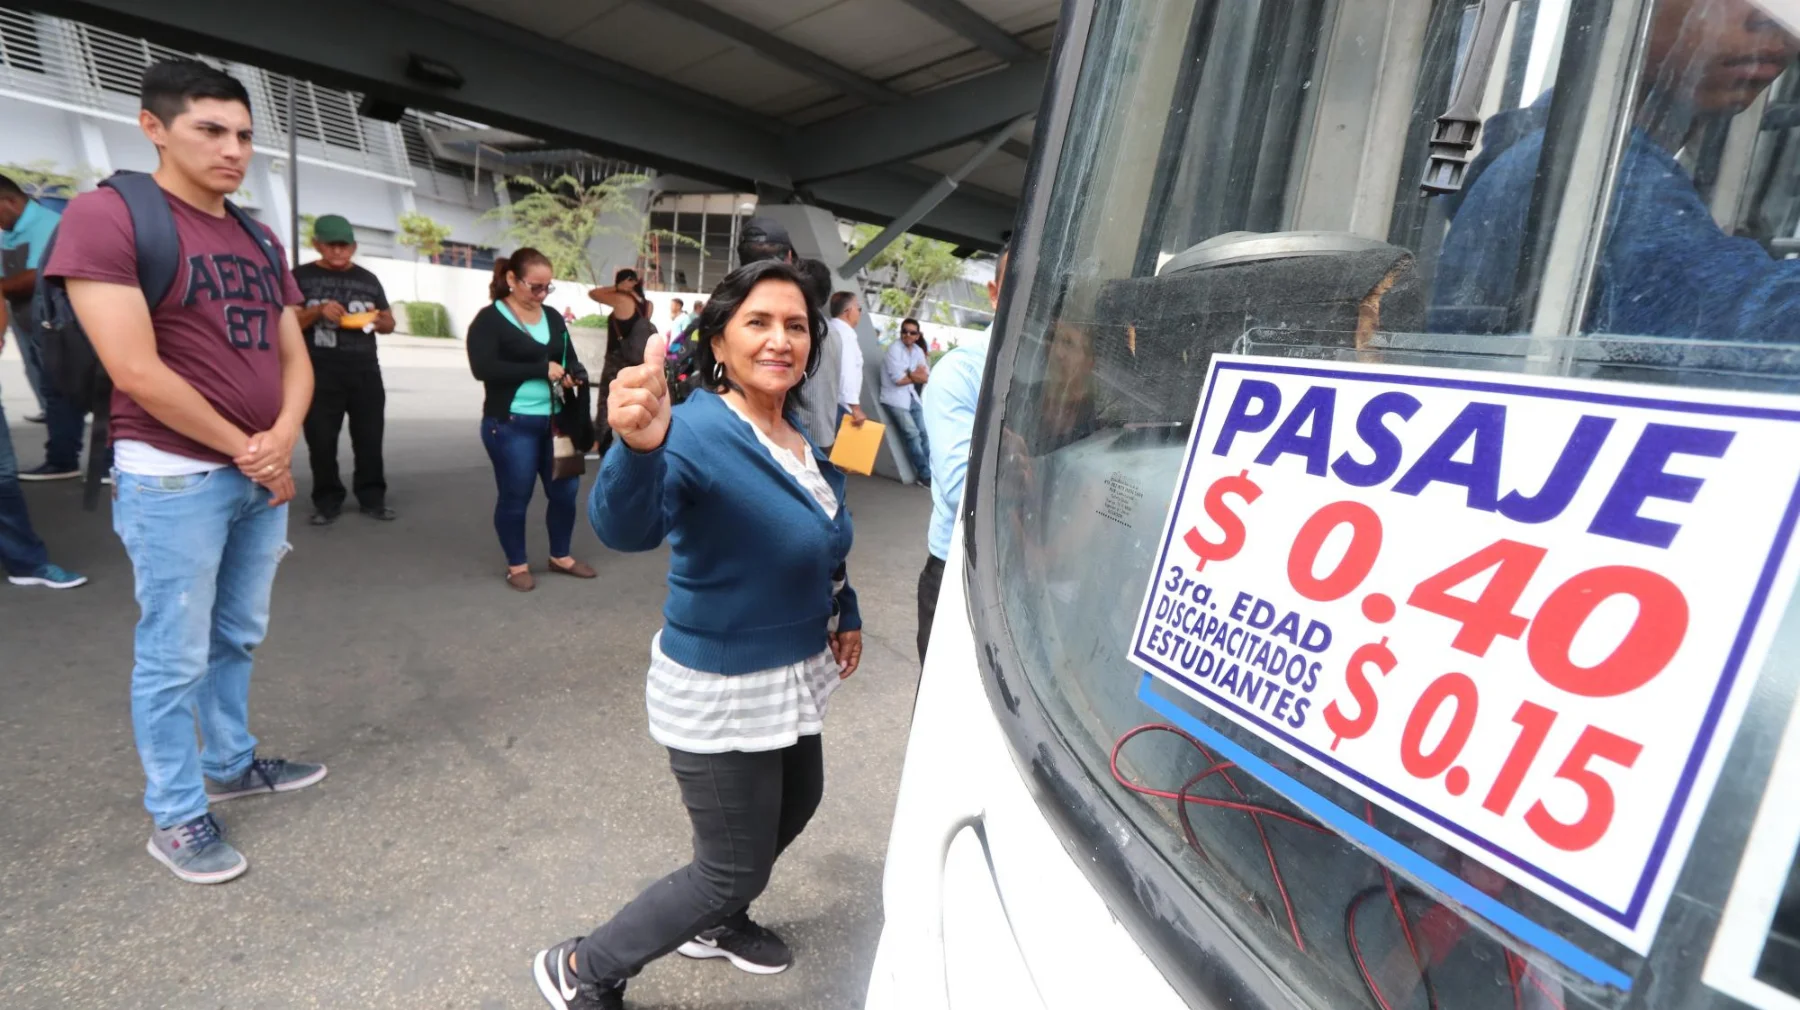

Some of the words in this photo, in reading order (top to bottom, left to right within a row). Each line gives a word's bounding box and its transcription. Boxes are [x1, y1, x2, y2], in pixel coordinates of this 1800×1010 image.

[225, 304, 270, 350] 87
[1212, 378, 1737, 549] PASAJE
[1165, 566, 1217, 611] 3ra.
[1229, 591, 1332, 653] EDAD
[1183, 469, 1263, 572] $
[1287, 500, 1689, 698] 0.40
[1147, 625, 1311, 729] ESTUDIANTES
[1155, 595, 1322, 693] DISCAPACITADOS
[1322, 636, 1398, 752] $
[1401, 672, 1644, 852] 0.15
